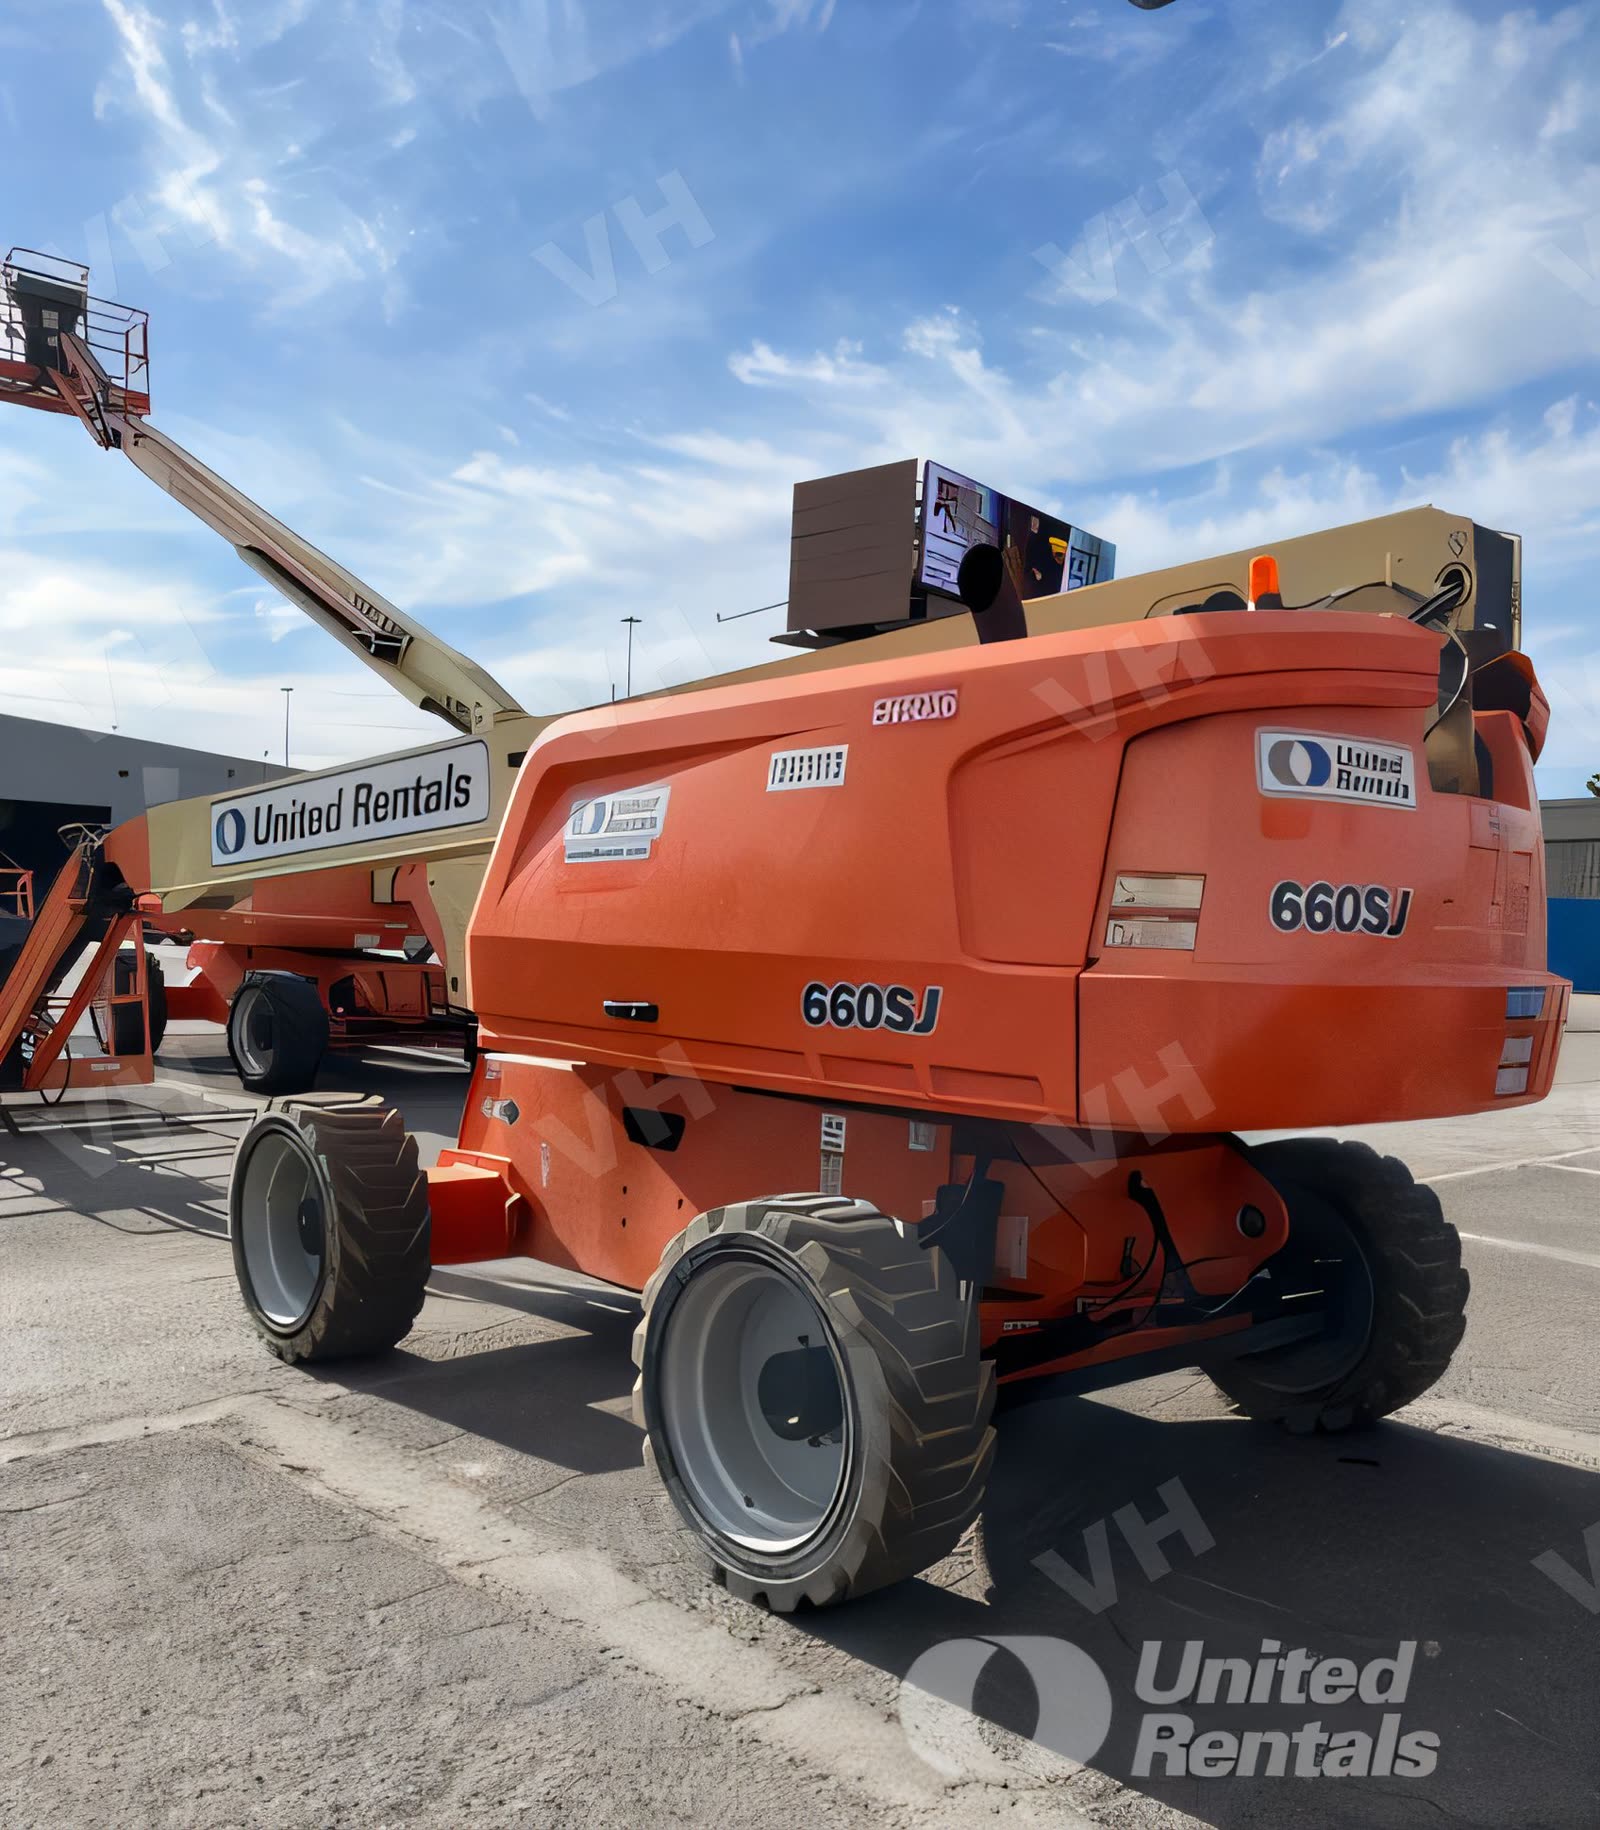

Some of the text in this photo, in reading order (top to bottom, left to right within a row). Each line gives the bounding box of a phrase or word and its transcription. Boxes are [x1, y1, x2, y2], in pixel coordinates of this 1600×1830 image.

[253, 763, 472, 845] United Rentals
[1271, 880, 1412, 937] 660SJ
[802, 982, 942, 1035] 660SJ
